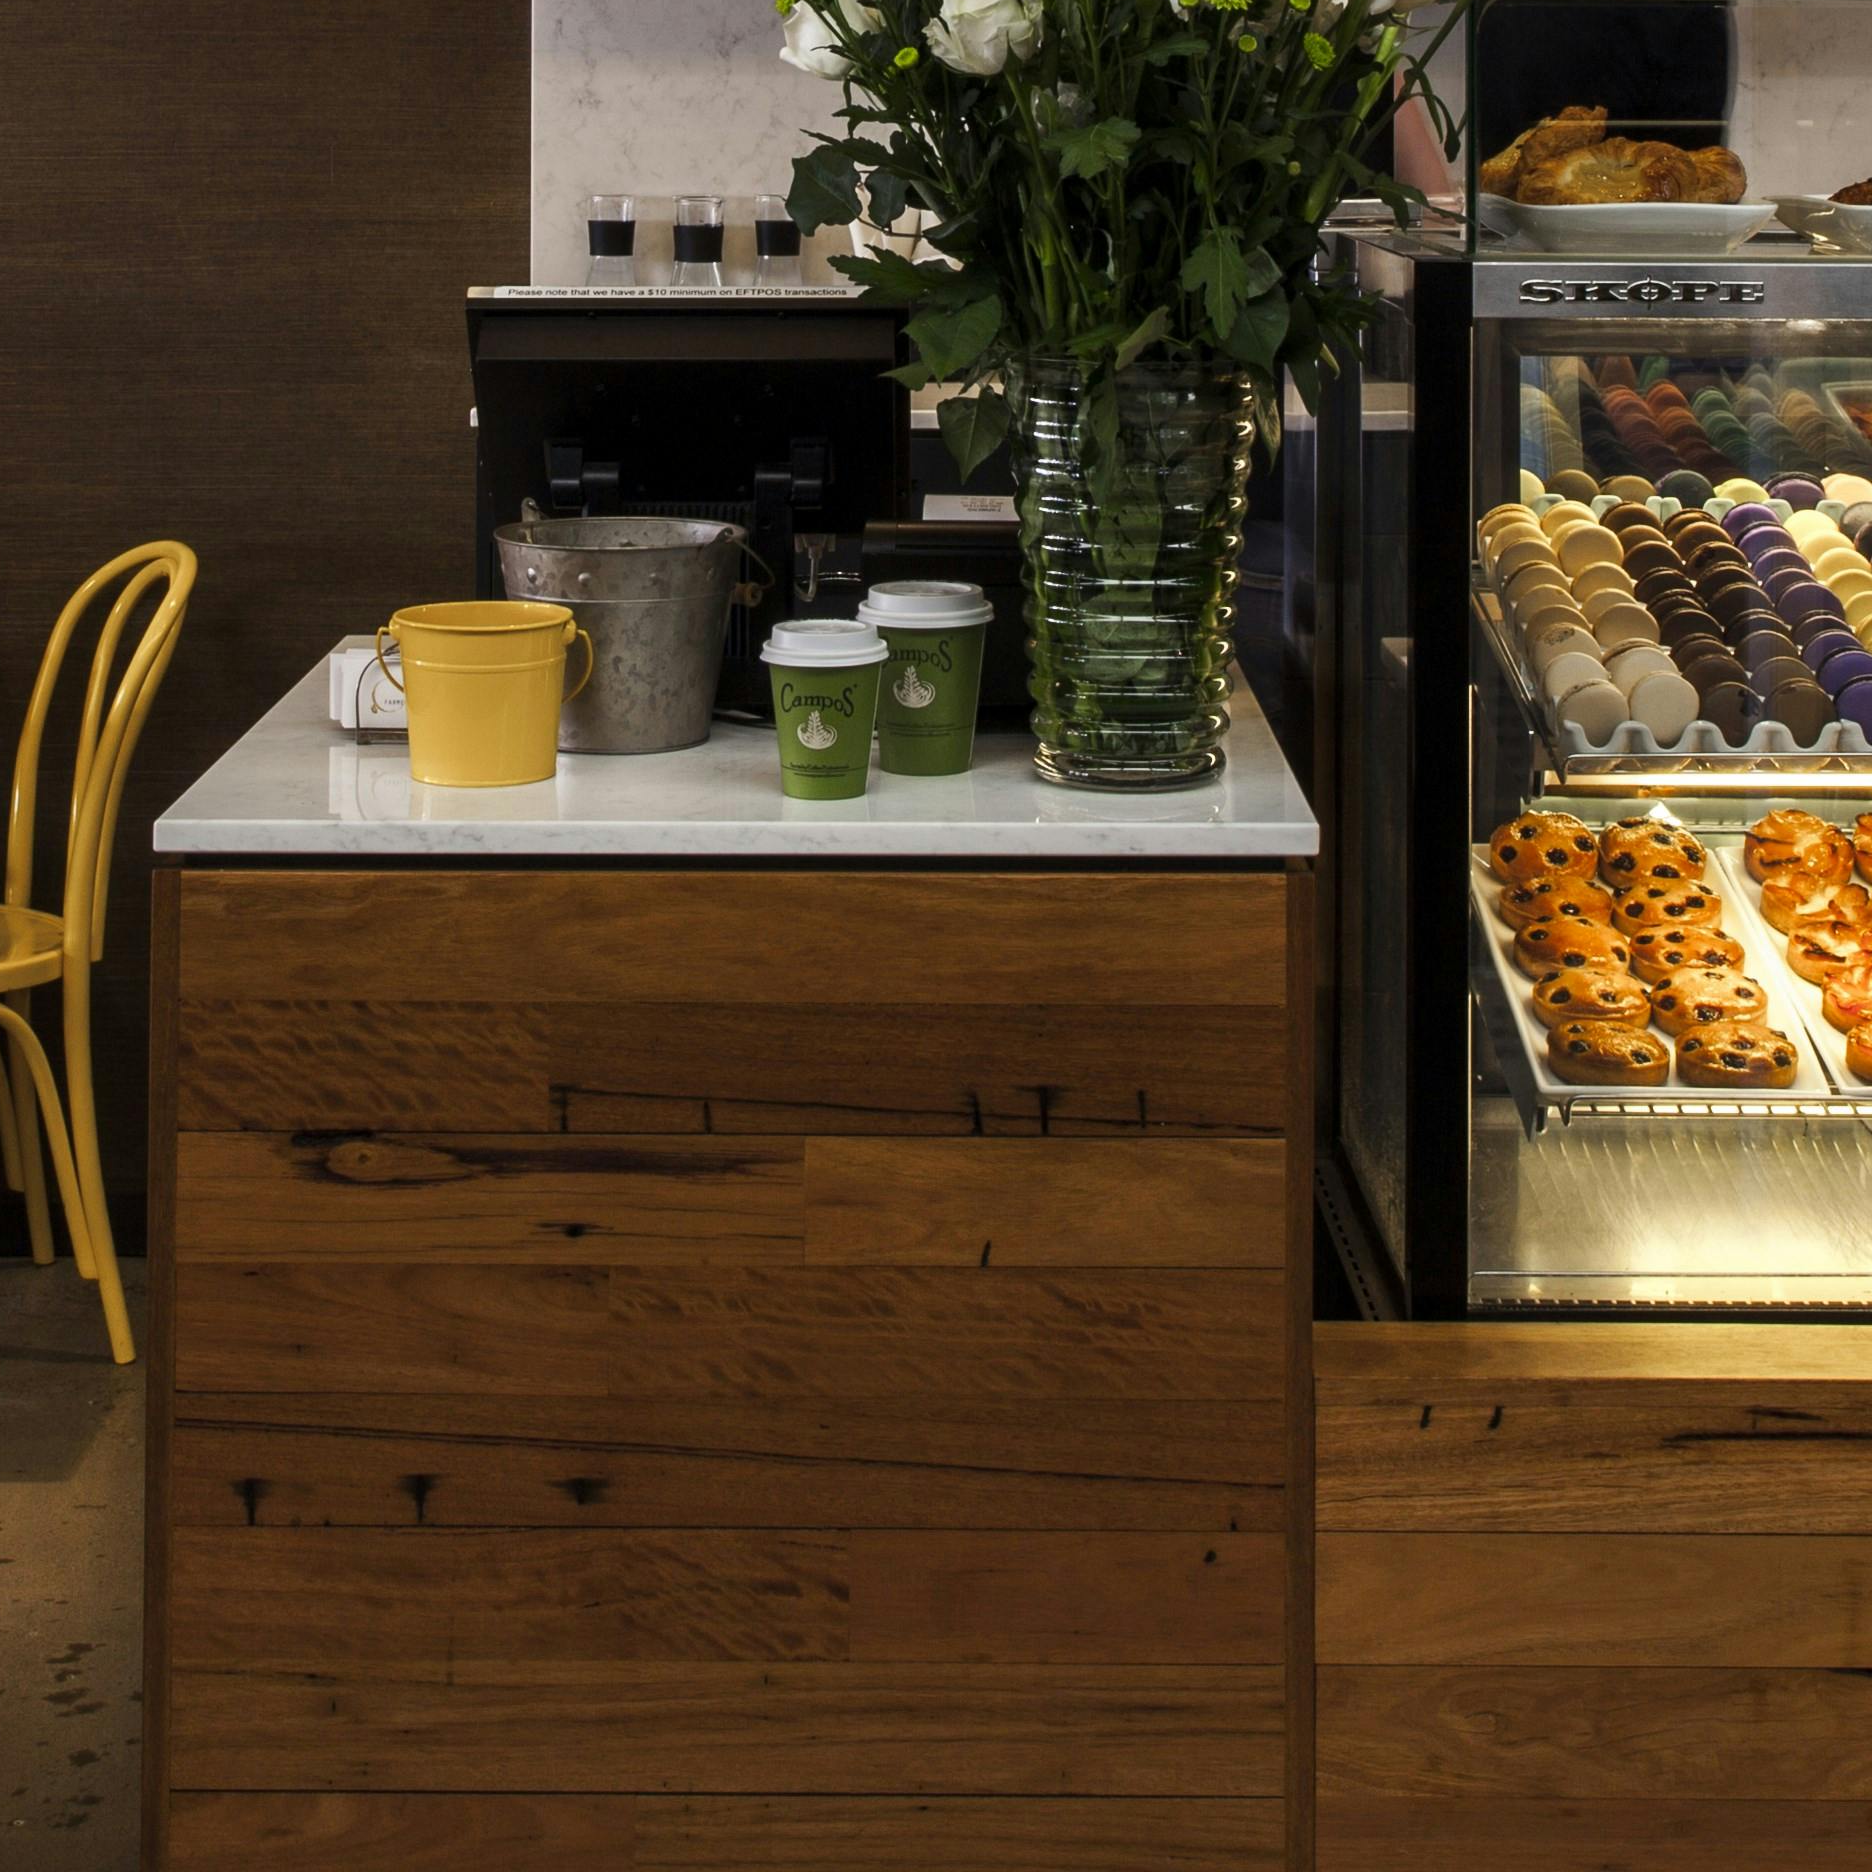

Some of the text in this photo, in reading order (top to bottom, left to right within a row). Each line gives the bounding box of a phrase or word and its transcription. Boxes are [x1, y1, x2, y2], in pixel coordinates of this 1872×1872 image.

[508, 288, 543, 296] Please
[570, 288, 590, 296] that
[611, 288, 636, 296] have
[647, 288, 667, 296] $10
[669, 288, 717, 296] minimum
[735, 288, 782, 296] EFTPOS
[784, 288, 848, 296] transactions
[1519, 277, 1764, 307] SKOPE
